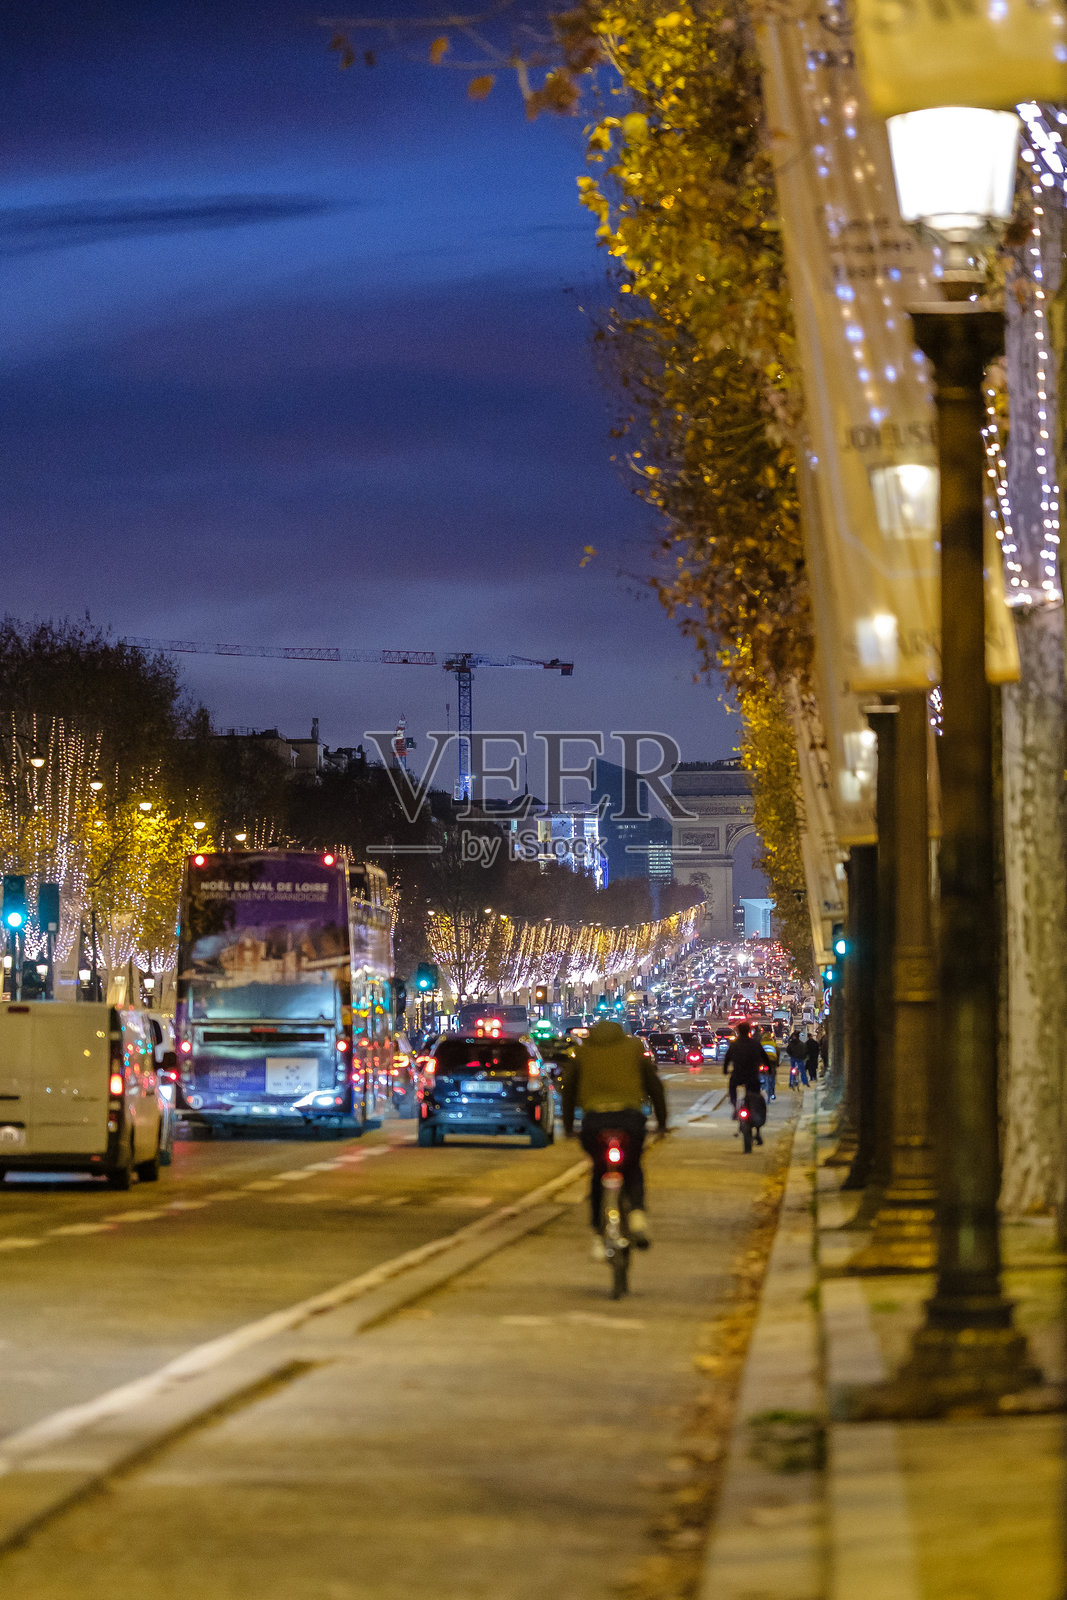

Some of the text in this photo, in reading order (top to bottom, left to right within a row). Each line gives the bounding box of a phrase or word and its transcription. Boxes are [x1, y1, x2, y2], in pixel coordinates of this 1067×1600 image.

[233, 881, 250, 891] EN
[251, 881, 273, 891] VAL
[276, 881, 292, 892] DE
[294, 882, 329, 893] LOIRE
